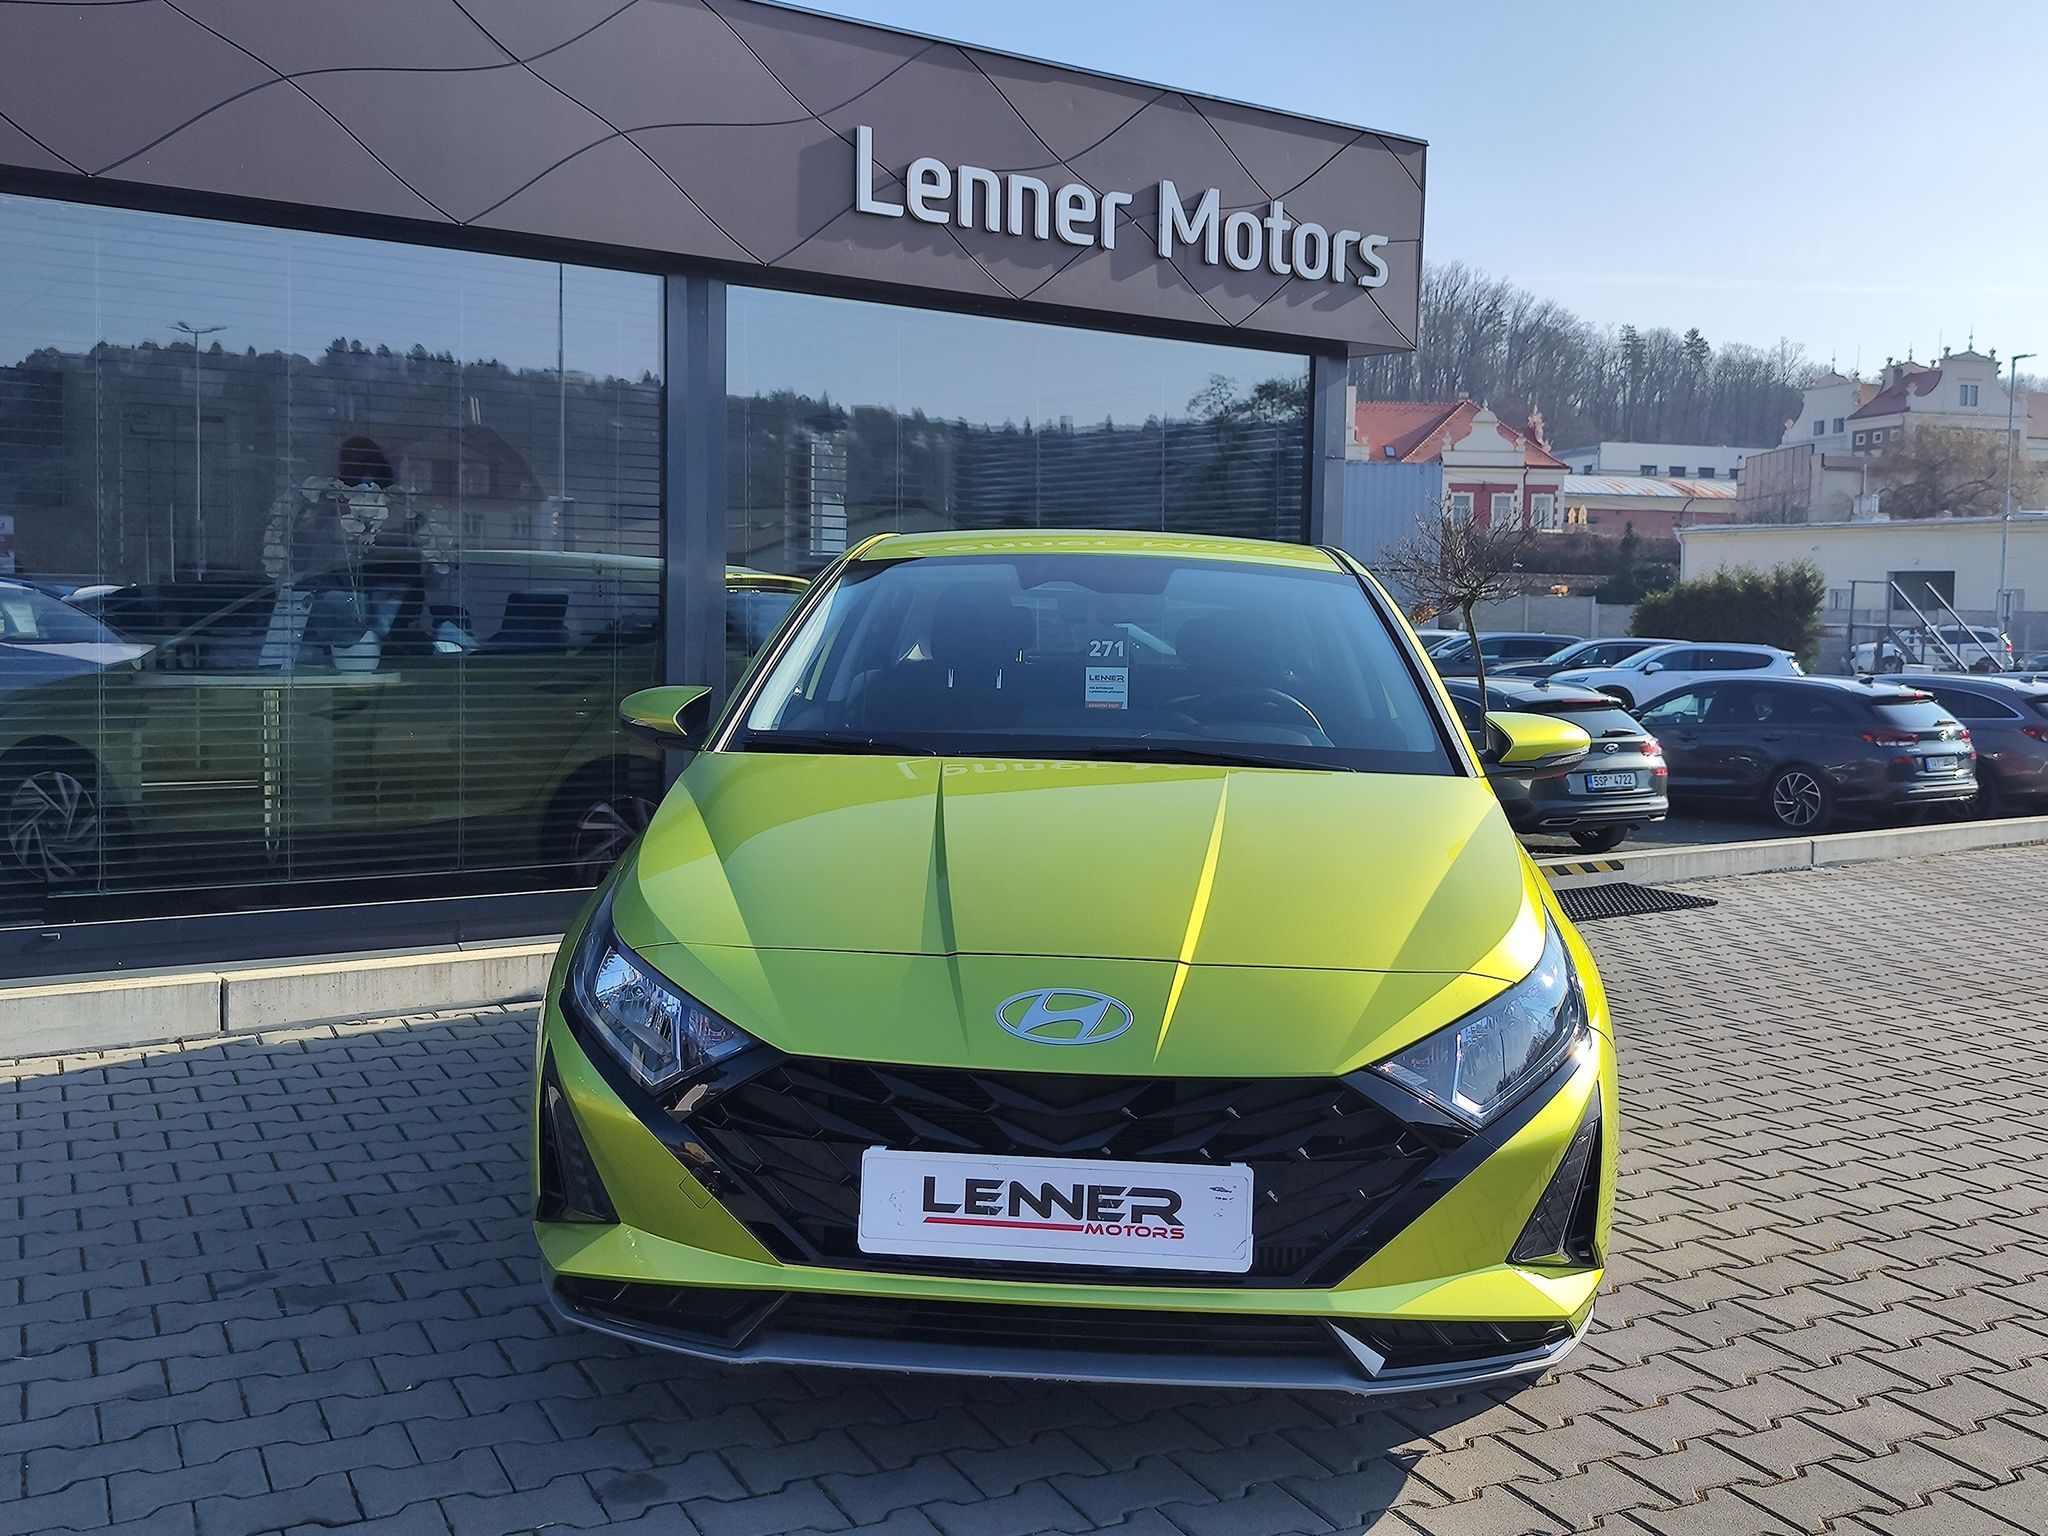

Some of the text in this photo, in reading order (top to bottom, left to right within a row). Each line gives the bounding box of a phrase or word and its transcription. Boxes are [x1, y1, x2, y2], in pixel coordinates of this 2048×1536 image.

[856, 125, 1389, 288] Lenner Motors
[1089, 640, 1124, 657] 271
[1089, 674, 1125, 683] LENNER
[1593, 774, 1632, 787] 5SP 4722
[923, 1175, 1185, 1226] LENNER
[1082, 1223, 1185, 1240] MOTORS
